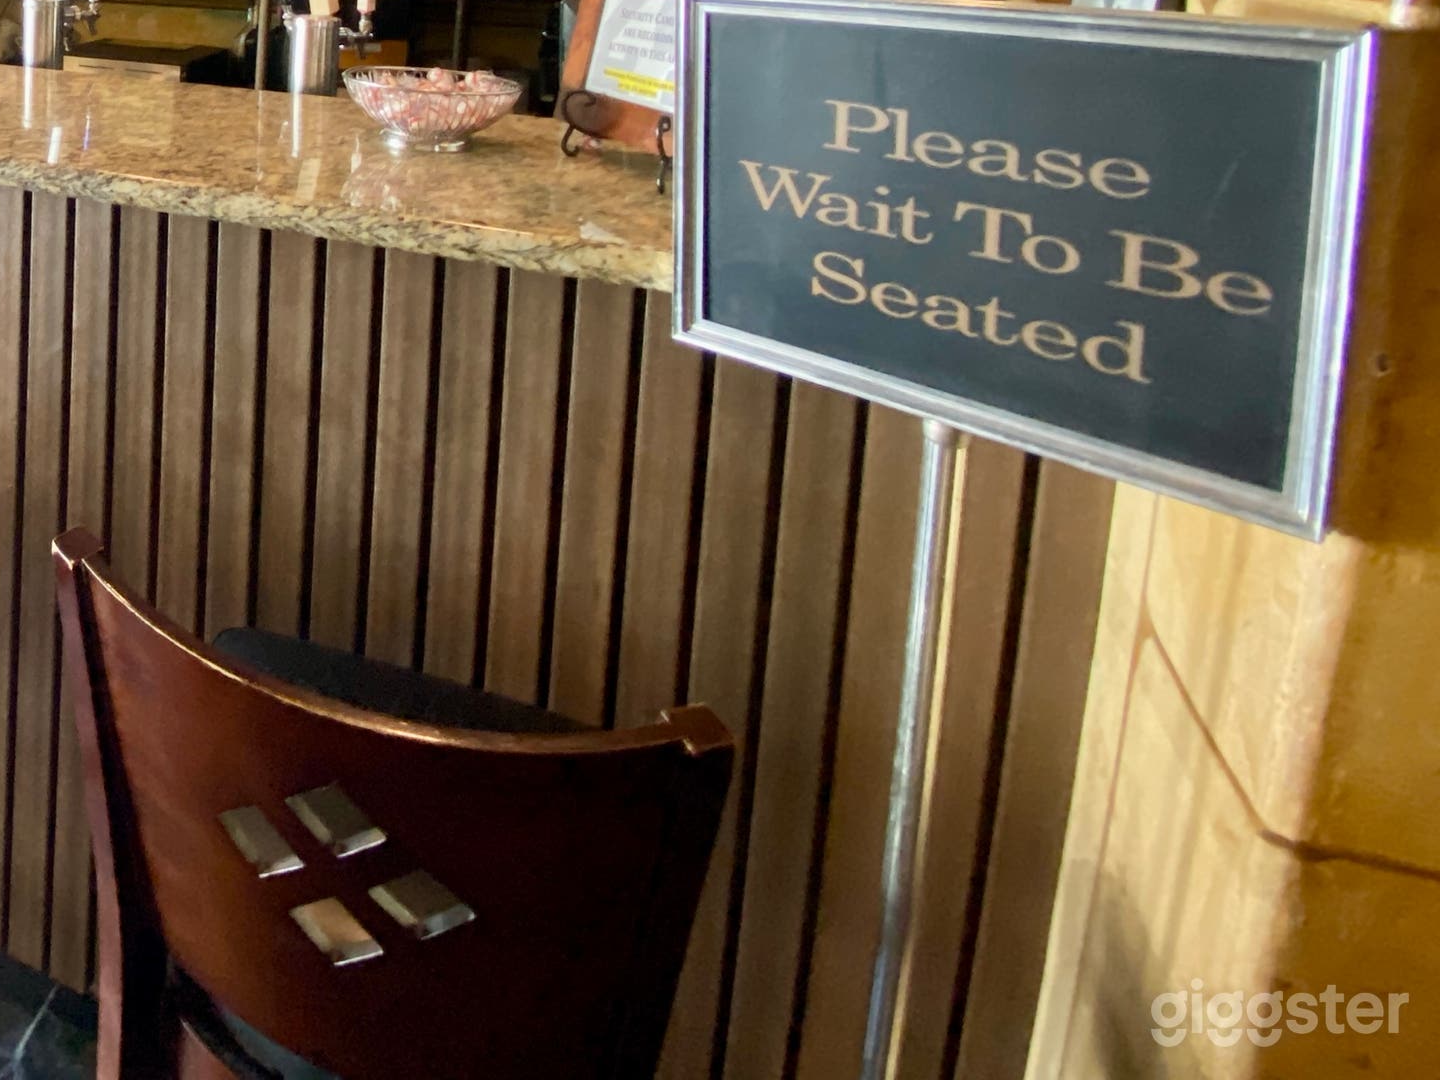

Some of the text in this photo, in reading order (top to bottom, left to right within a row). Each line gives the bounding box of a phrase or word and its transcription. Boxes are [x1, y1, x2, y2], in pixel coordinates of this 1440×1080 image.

[822, 98, 1152, 200] Please
[738, 159, 1274, 316] Wait To Be
[810, 250, 1152, 385] Seated
